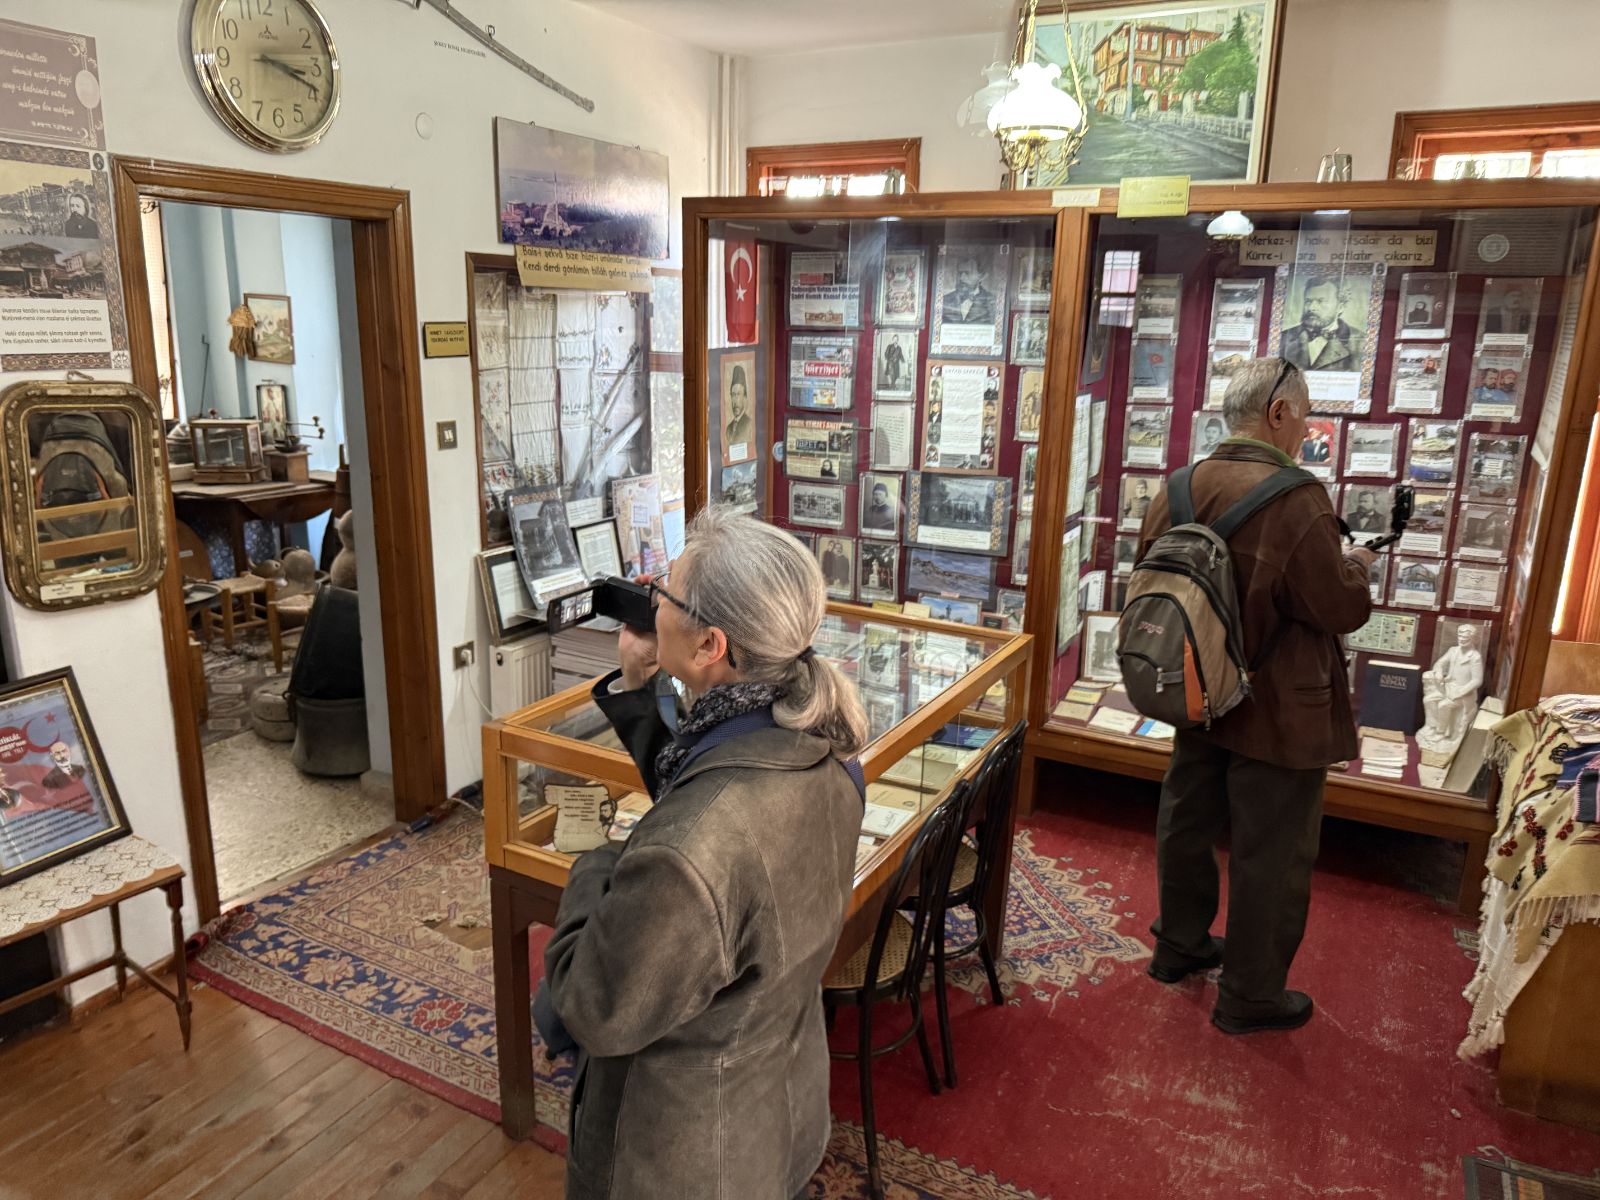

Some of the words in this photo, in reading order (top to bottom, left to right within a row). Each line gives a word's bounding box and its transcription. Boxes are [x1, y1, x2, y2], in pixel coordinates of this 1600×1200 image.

[256, 0, 273, 17] 12
[284, 6, 290, 27] 1
[221, 18, 239, 41] 10
[298, 27, 312, 49] 2
[216, 46, 230, 68] 9
[310, 56, 322, 78] 3
[229, 76, 243, 99] 8
[307, 84, 319, 103] 4
[252, 100, 263, 122] 7
[272, 107, 285, 128] 6
[293, 103, 304, 123] 5
[1387, 235, 1403, 246] da
[1415, 235, 1434, 246] bizi
[523, 260, 542, 272] Kendi
[543, 262, 561, 273] derdi
